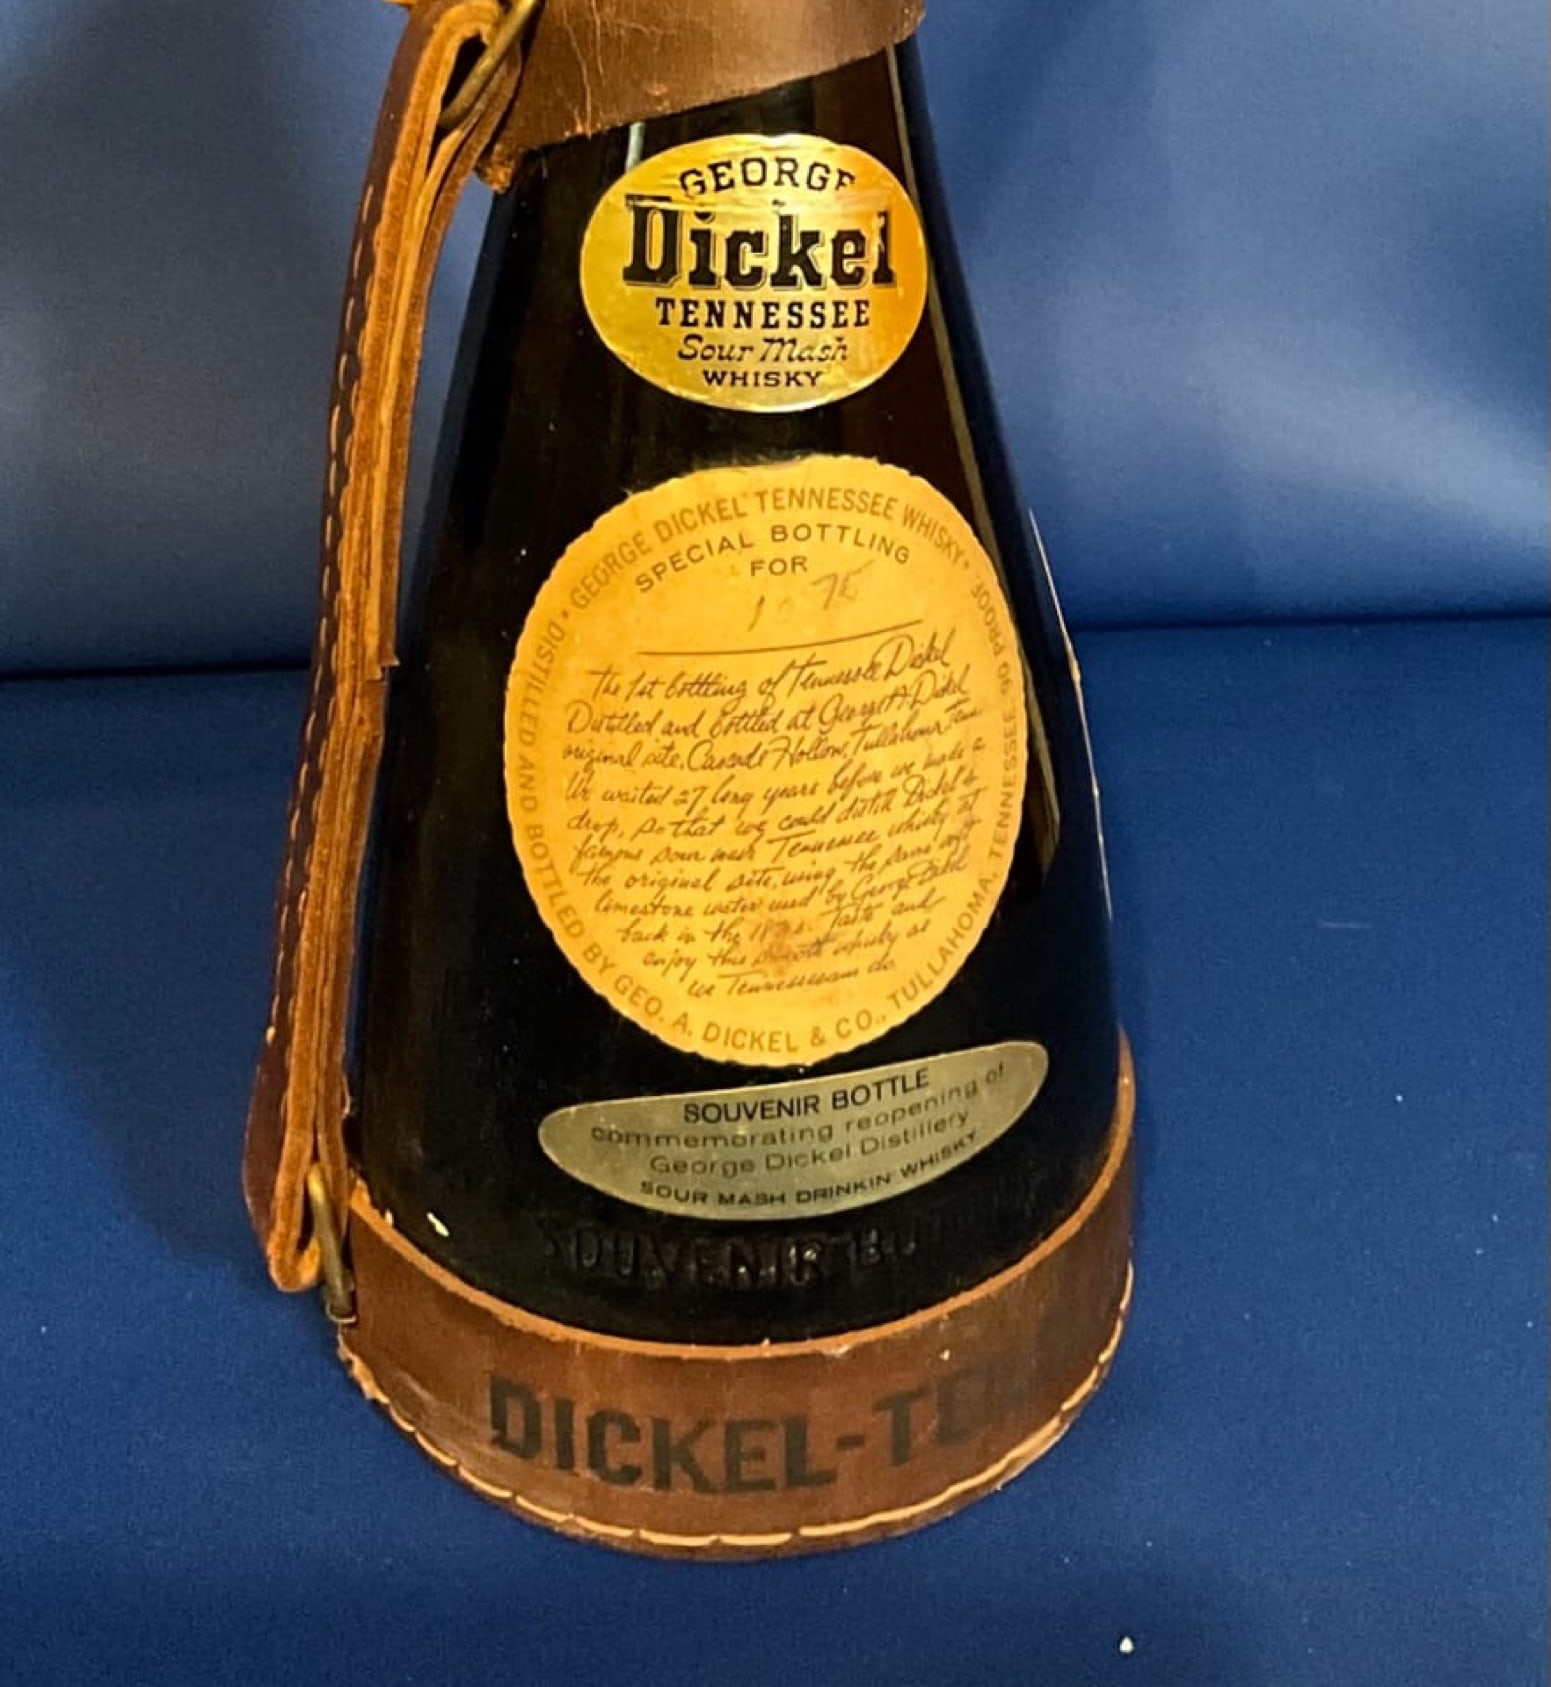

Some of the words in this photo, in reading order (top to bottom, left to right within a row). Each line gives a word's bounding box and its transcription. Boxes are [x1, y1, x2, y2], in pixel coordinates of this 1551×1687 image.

[622, 194, 897, 291] Dickel
[655, 297, 870, 329] TENNESSEE
[677, 333, 754, 362] Sour
[760, 336, 848, 362] Mash
[703, 369, 822, 388] WHISKY
[569, 530, 652, 610] GEORGE
[754, 487, 899, 521] TENNESSEE
[902, 503, 965, 564] WHISKY
[635, 533, 754, 593] SPECIAL
[771, 522, 910, 565] BOTTLING
[750, 554, 808, 577] FOR
[517, 618, 566, 747] DISTILLED
[665, 671, 747, 715] bottling
[758, 660, 796, 718] of
[661, 709, 705, 738] and
[787, 705, 816, 731] at
[517, 755, 538, 814] AND
[562, 739, 643, 773] original
[602, 780, 674, 805] waited
[674, 786, 707, 816] 27
[711, 774, 754, 819] long
[763, 782, 819, 815] years
[827, 759, 883, 801] before
[890, 761, 915, 778] we
[630, 817, 665, 841] so
[669, 806, 725, 837] that
[735, 820, 768, 838] we
[778, 801, 837, 831] could
[525, 823, 586, 940] BOTTLED
[625, 867, 721, 900] original
[781, 860, 837, 896] using
[844, 843, 882, 872] the
[649, 845, 705, 866] sour
[595, 888, 694, 917] limestone
[704, 897, 757, 917] water
[768, 885, 819, 911] used
[616, 917, 668, 942] back
[677, 926, 696, 944] in
[704, 916, 745, 945] the
[891, 886, 946, 916] and
[583, 941, 616, 977] BY
[642, 948, 698, 983] enjoy
[707, 948, 746, 968] this
[906, 917, 930, 939] as
[613, 973, 665, 1022] GEO.
[687, 979, 716, 999] we
[703, 1020, 800, 1054] DICKEL
[810, 1024, 827, 1048] &
[591, 1123, 833, 1148] commemorating
[845, 1079, 978, 1132] reopening
[985, 1061, 1004, 1084] of
[683, 1094, 820, 1124] SOUVENIR
[832, 1066, 930, 1111] BOTTLE
[640, 1180, 708, 1205] SOUR
[718, 1191, 785, 1206] MASH
[901, 1130, 977, 1179] WHISKY
[650, 1155, 755, 1179] George
[766, 1144, 850, 1171] Dickel
[860, 1109, 968, 1156] Distillery
